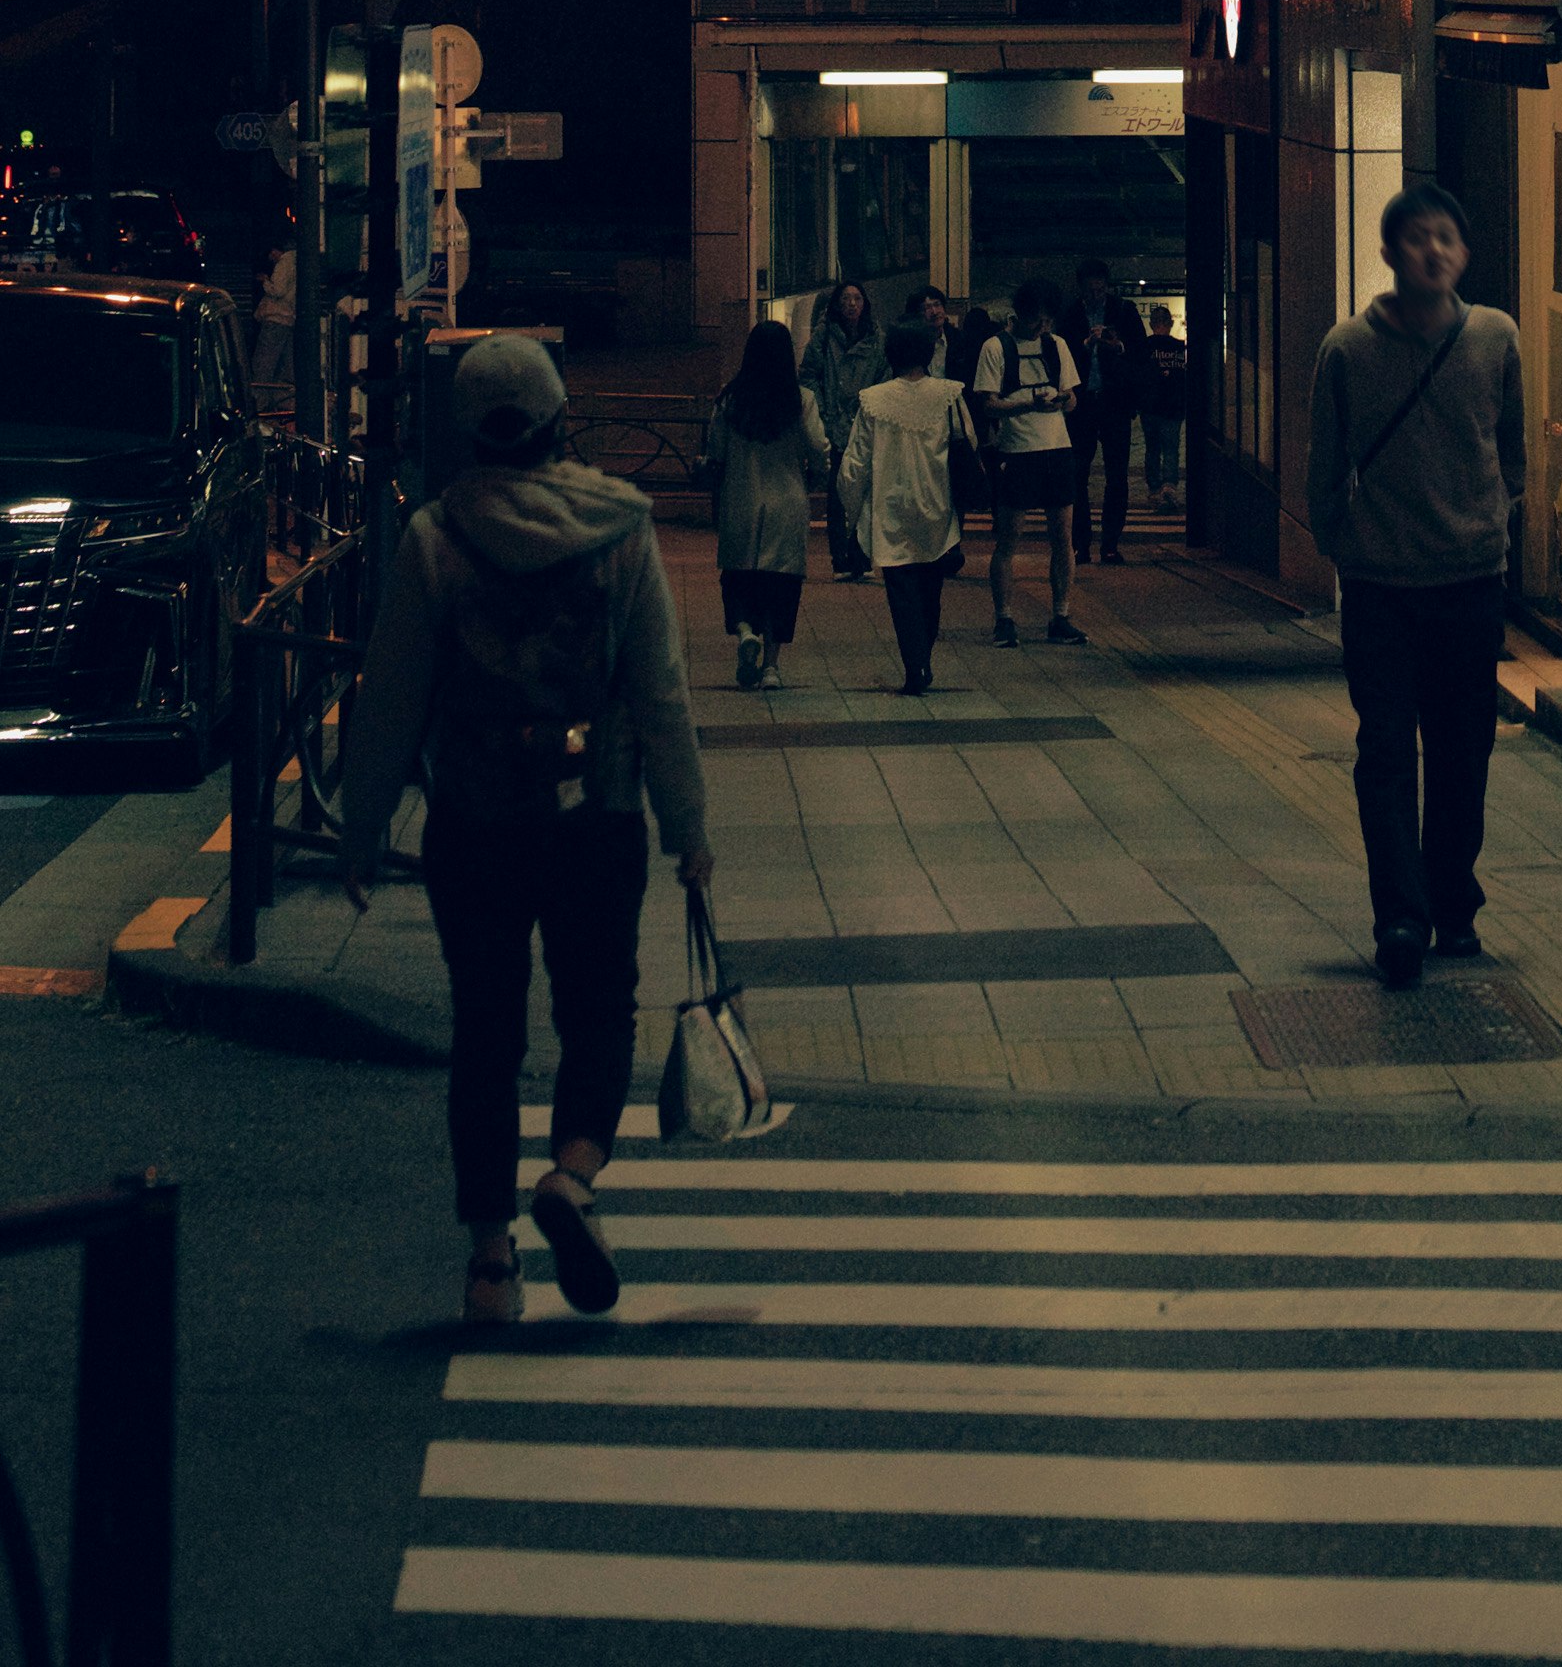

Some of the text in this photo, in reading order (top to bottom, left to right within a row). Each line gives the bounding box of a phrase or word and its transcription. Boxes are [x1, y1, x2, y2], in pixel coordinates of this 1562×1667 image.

[233, 122, 262, 141] 405
[1121, 118, 1184, 132] エトワール
